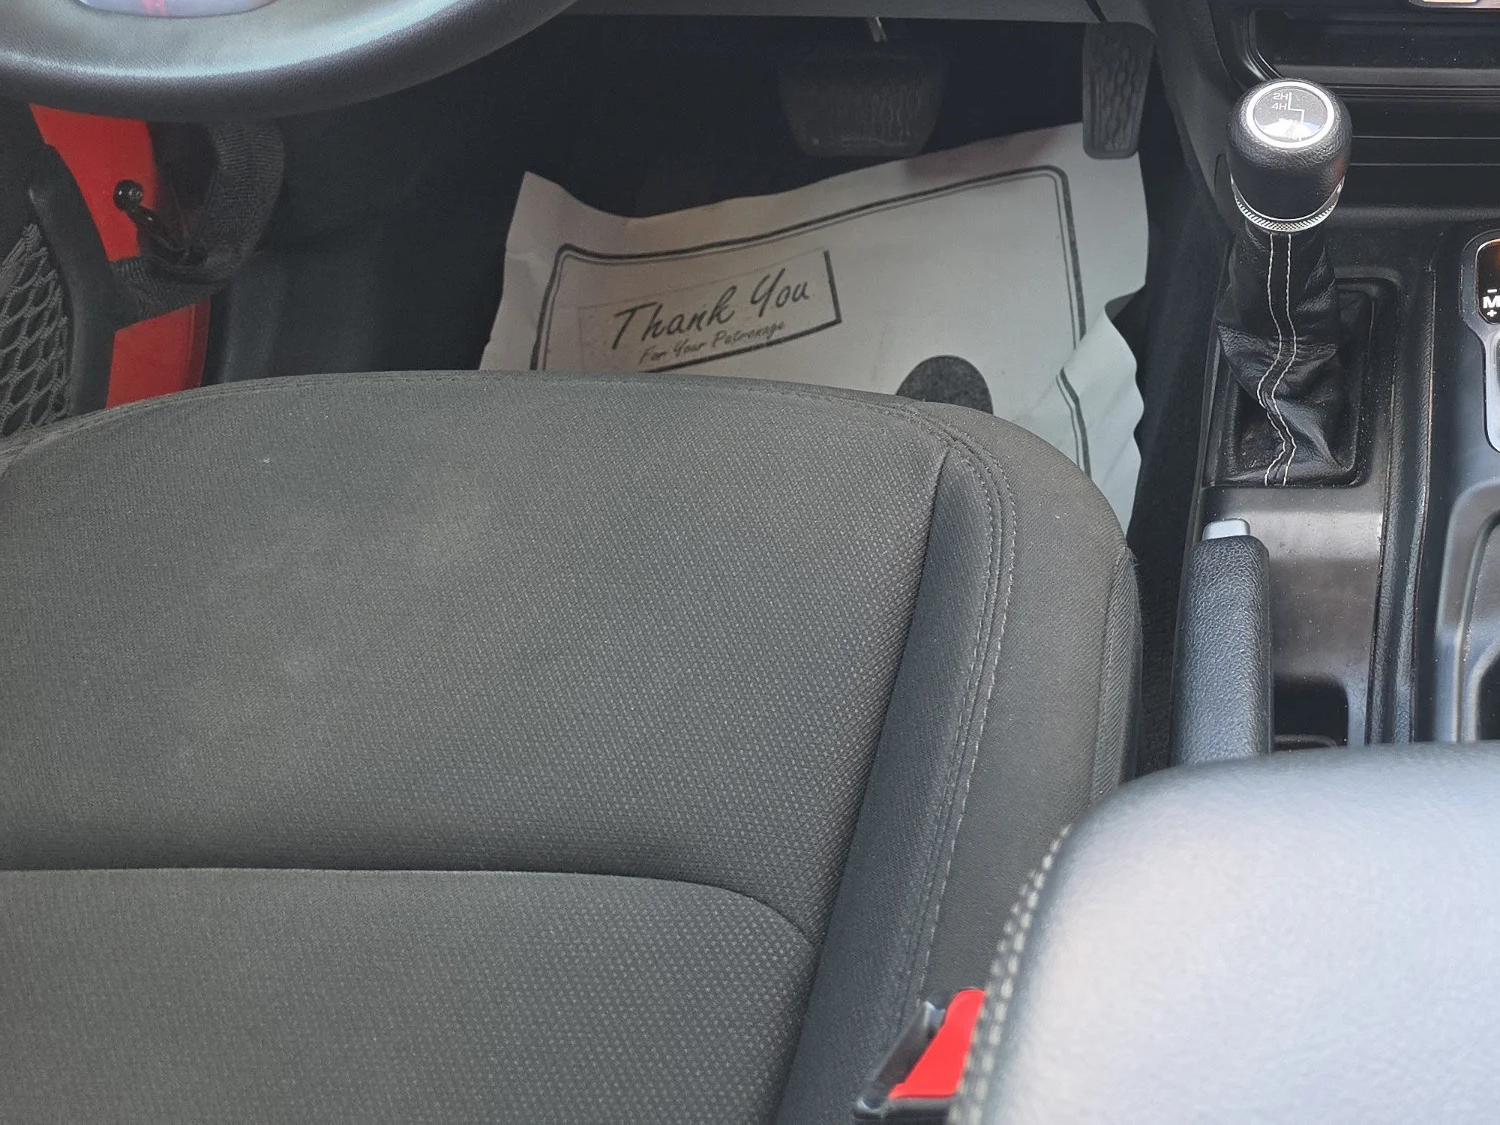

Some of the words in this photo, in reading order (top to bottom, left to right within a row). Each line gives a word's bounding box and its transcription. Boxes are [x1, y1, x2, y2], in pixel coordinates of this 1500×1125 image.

[1273, 92, 1288, 100] 2H
[613, 285, 737, 350] Thank
[751, 267, 809, 317] You
[1483, 295, 1500, 309] M
[639, 348, 667, 364] For
[673, 338, 705, 357] Your
[713, 321, 785, 347] Patronage
